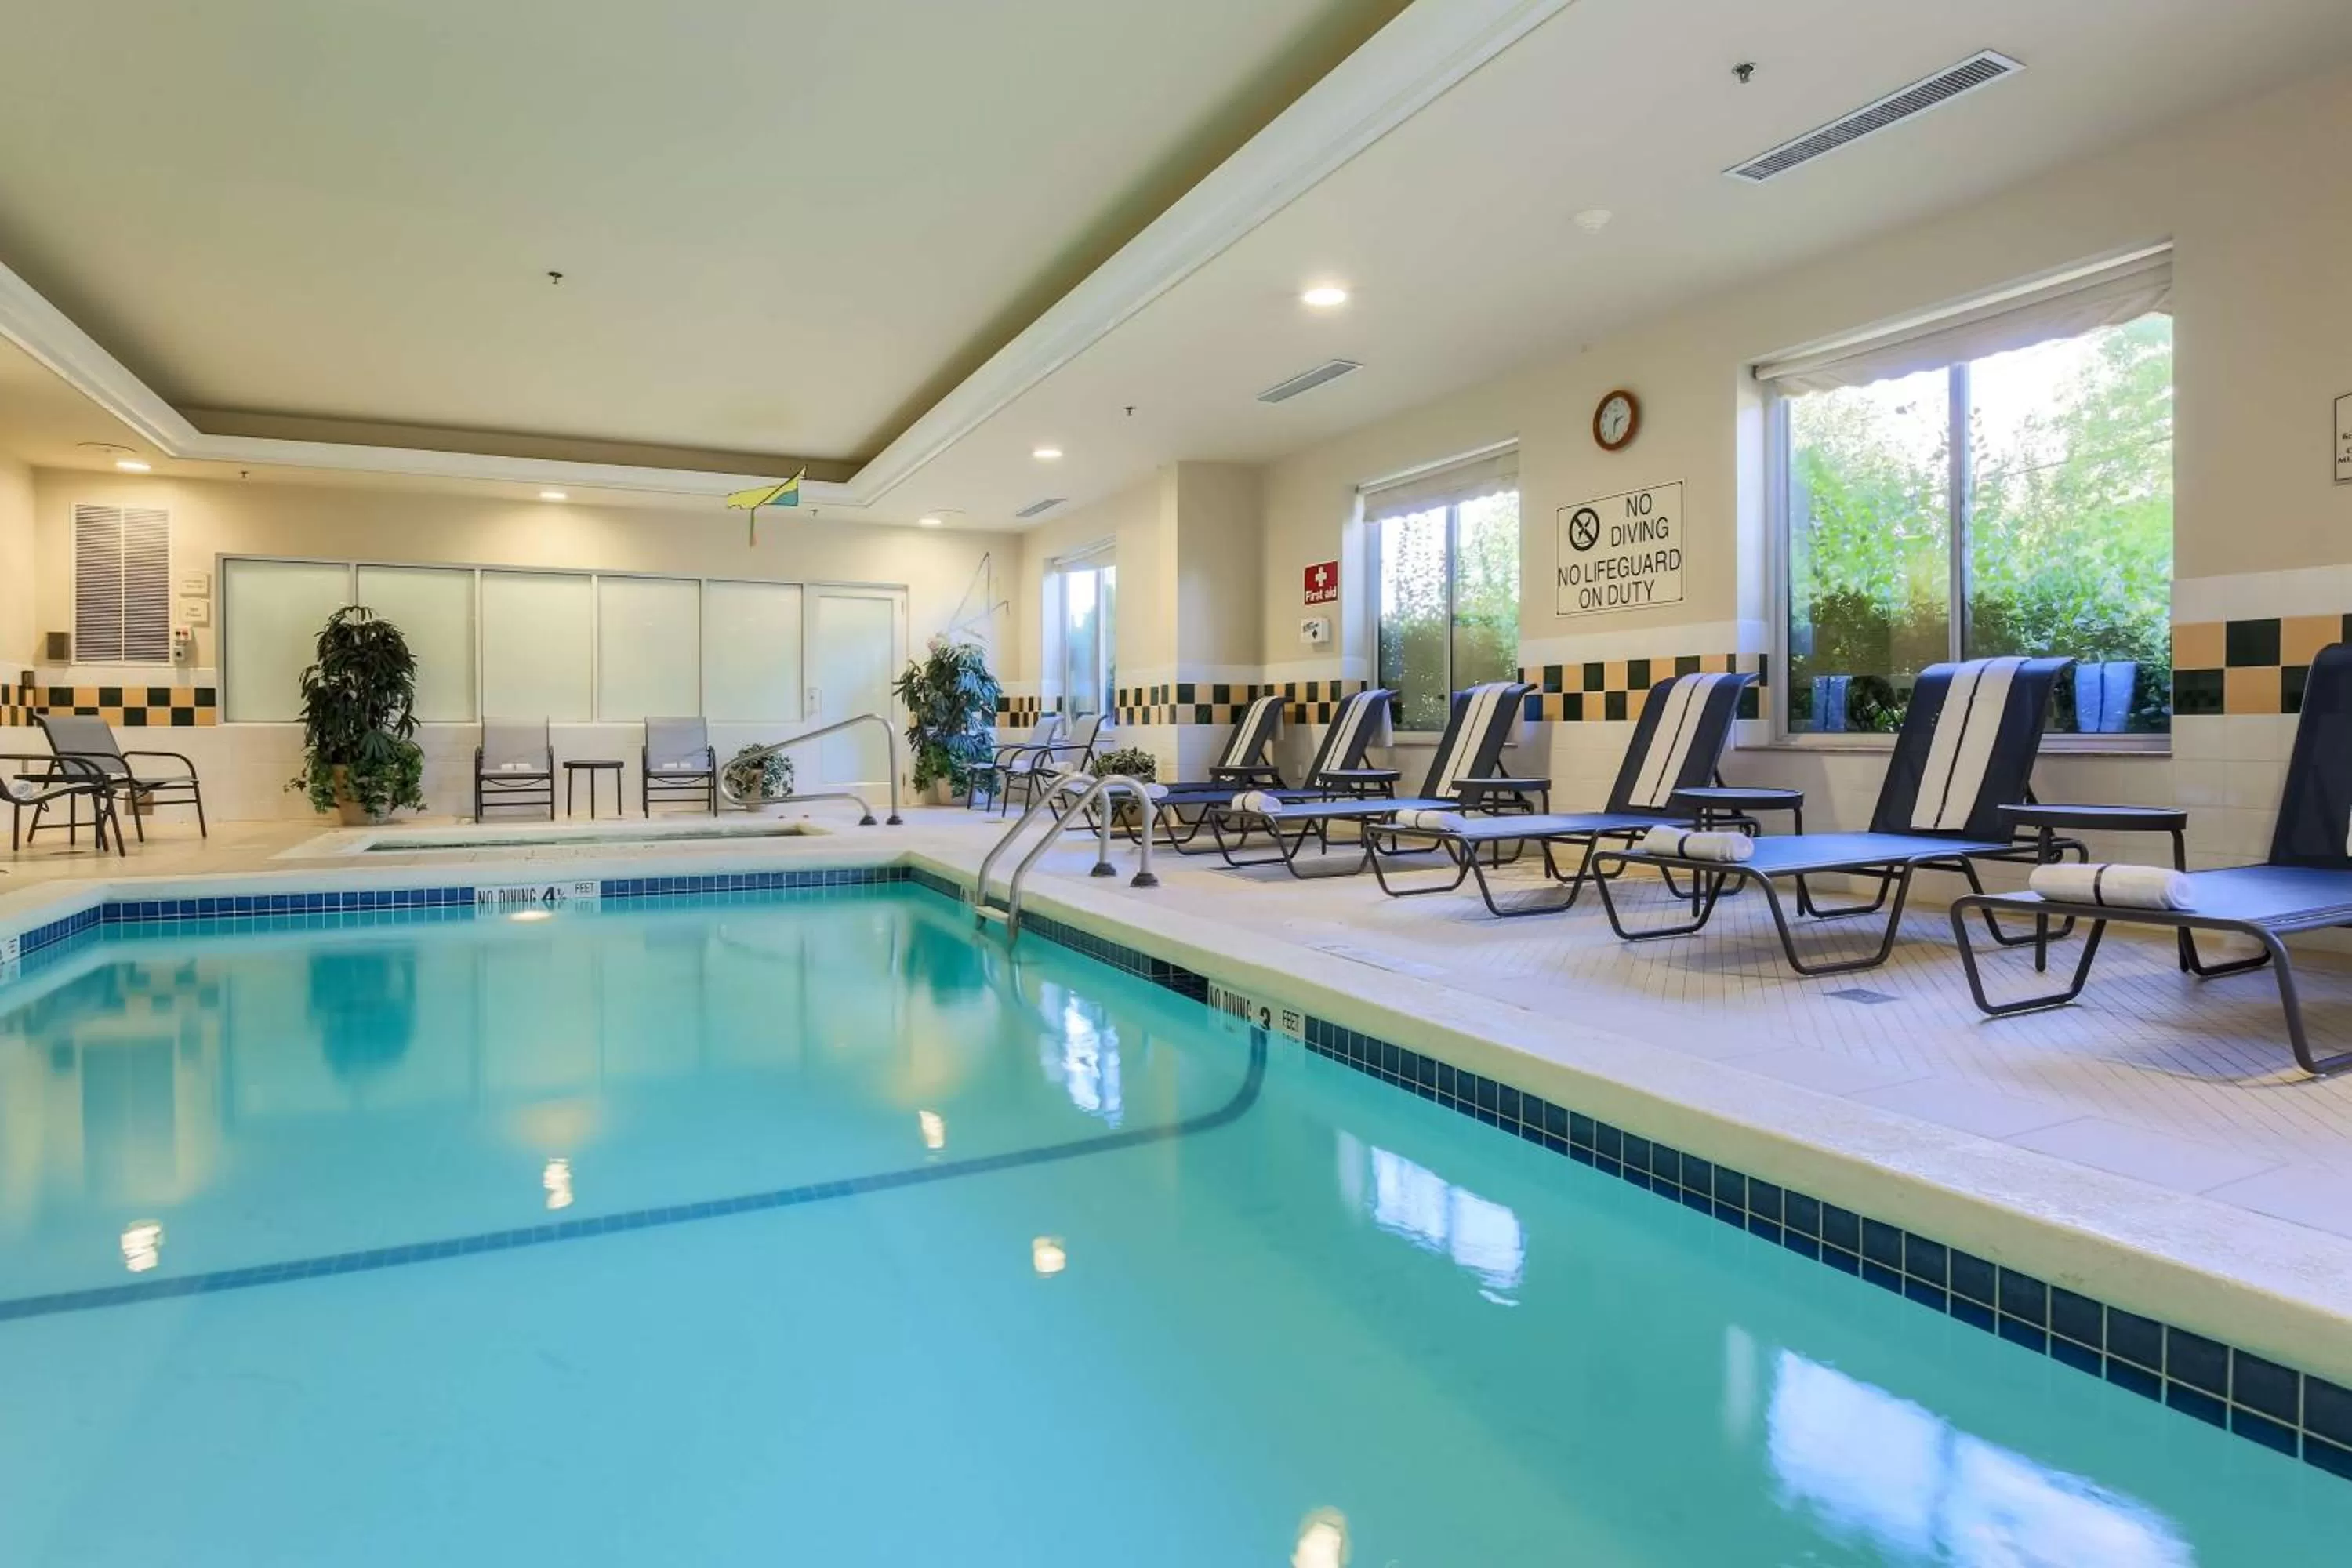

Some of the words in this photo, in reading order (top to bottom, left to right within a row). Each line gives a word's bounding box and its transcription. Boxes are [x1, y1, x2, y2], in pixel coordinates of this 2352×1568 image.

[1626, 493, 1652, 517] NO
[1611, 517, 1669, 547] DIVING
[1558, 564, 1581, 587] NO
[1585, 549, 1682, 583] LIFEGUARD
[1305, 589, 1323, 602] First
[1325, 586, 1337, 598] aid
[1579, 586, 1602, 609] ON
[1608, 579, 1655, 605] DUTY
[477, 890, 493, 903] NO
[499, 887, 537, 903] DIVING
[575, 882, 595, 895] FEET
[1259, 1006, 1271, 1030] 3
[1282, 1009, 1299, 1032] FEET
